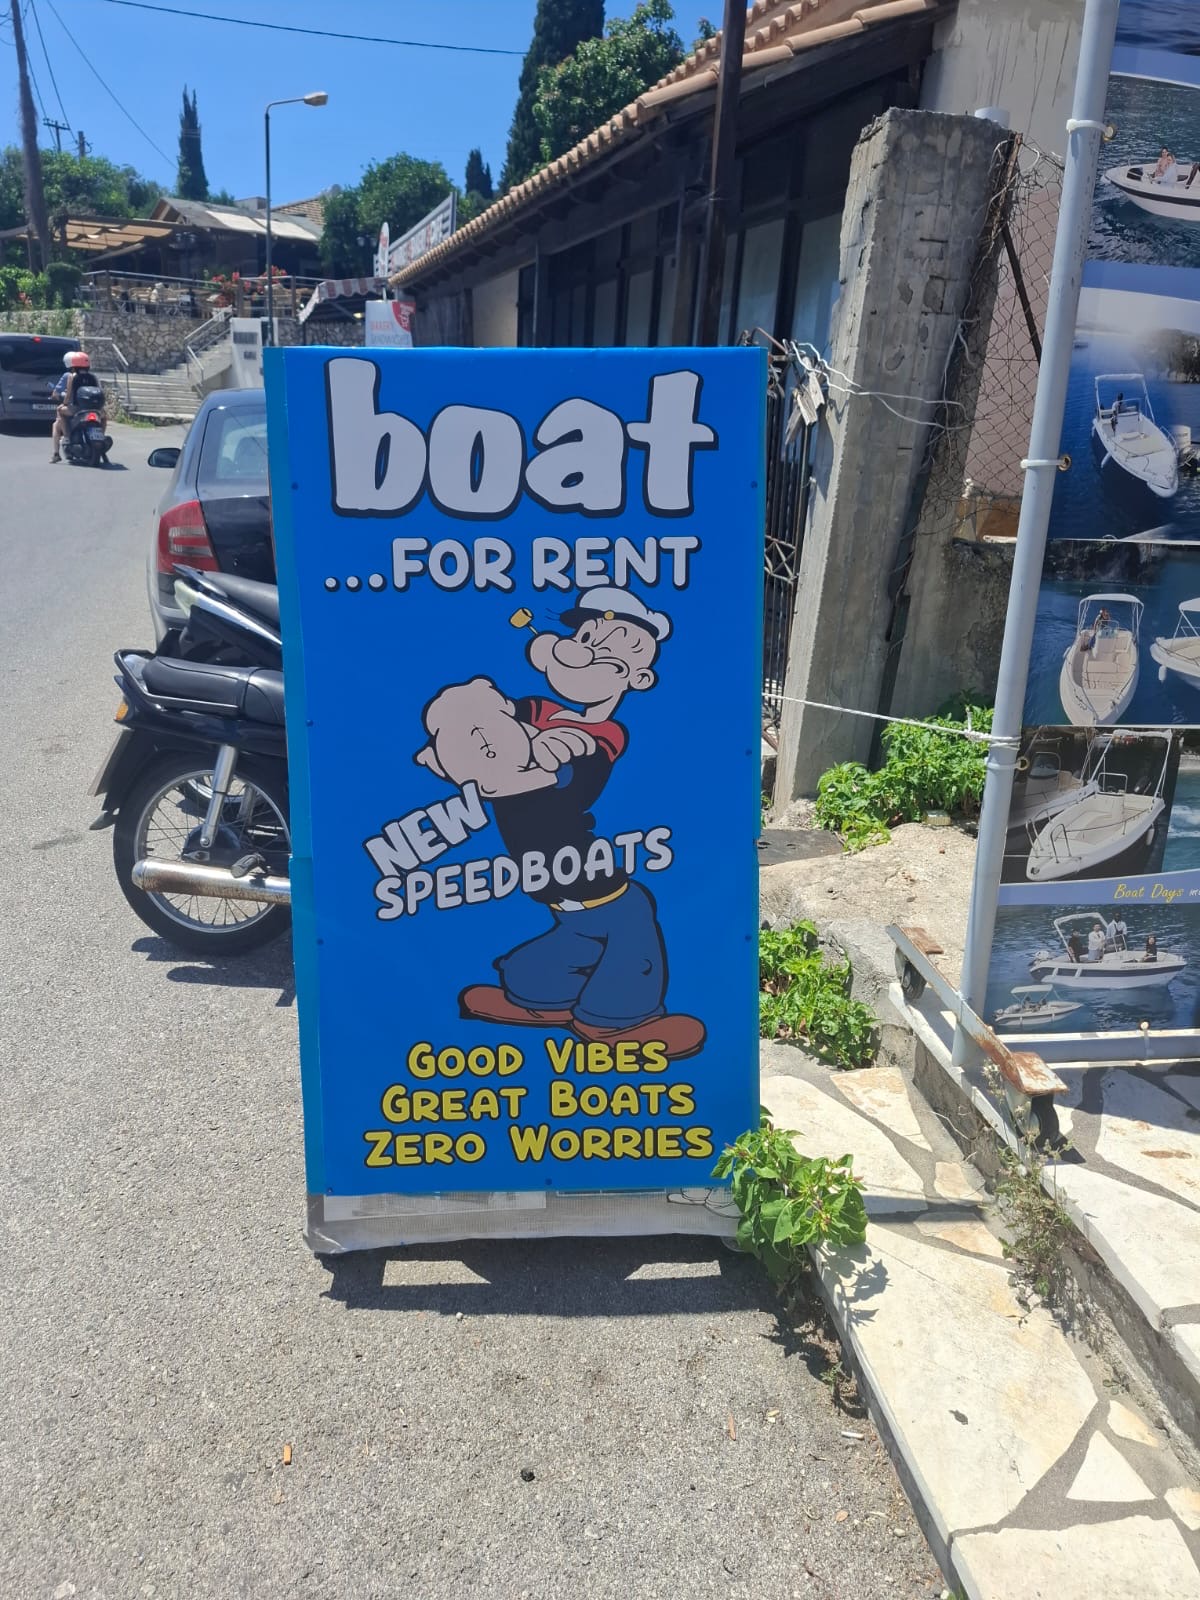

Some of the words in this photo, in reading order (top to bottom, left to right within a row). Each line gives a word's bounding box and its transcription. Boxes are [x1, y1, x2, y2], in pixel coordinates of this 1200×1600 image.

[326, 357, 719, 520] boat
[530, 536, 702, 590] RENT
[363, 780, 490, 877] NEW
[374, 826, 673, 920] SPEEDBOATS
[1114, 884, 1145, 899] Boat
[1151, 884, 1184, 904] Days
[407, 1041, 524, 1079] GOOD
[545, 1038, 670, 1074] VIBES
[381, 1084, 528, 1123] GREAT
[549, 1079, 696, 1116] BOATS
[364, 1130, 486, 1167] ZERO
[509, 1124, 714, 1161] WORRIES
